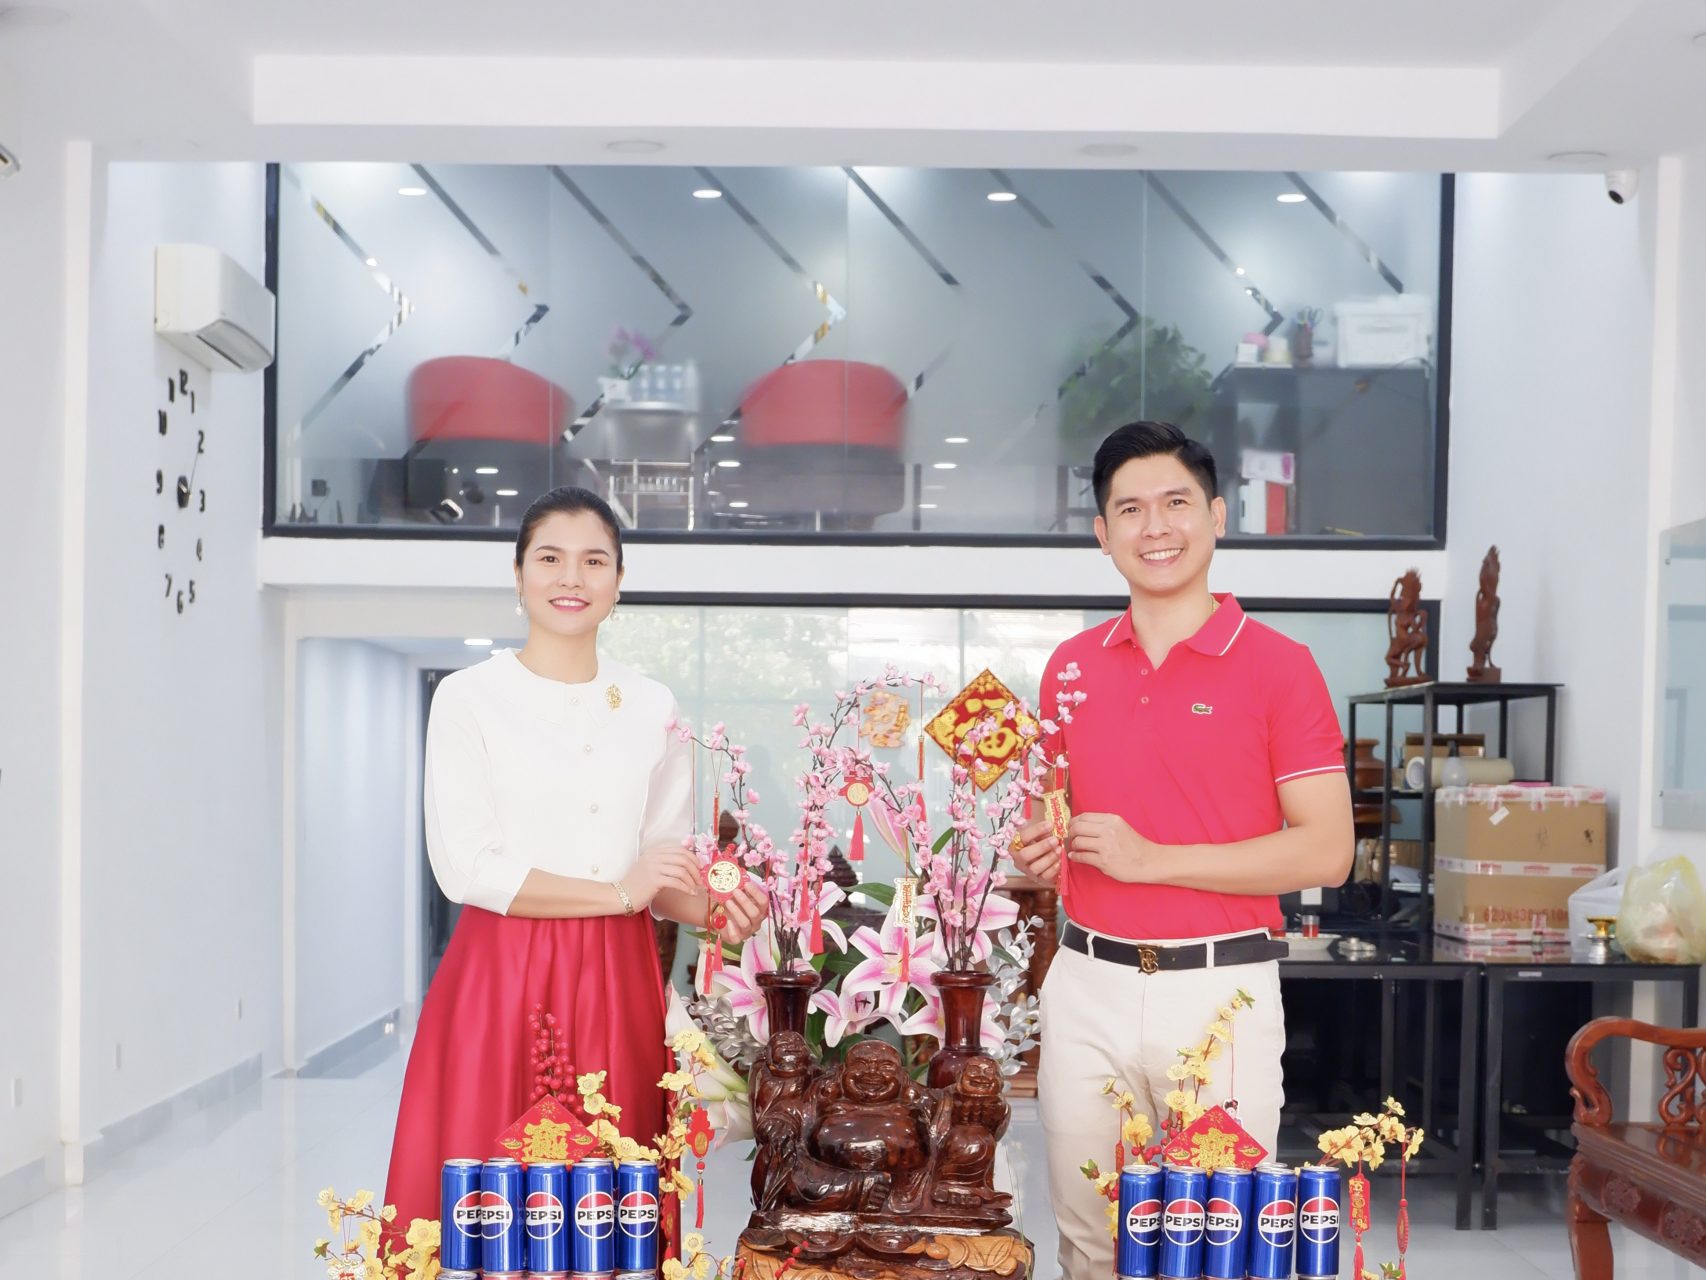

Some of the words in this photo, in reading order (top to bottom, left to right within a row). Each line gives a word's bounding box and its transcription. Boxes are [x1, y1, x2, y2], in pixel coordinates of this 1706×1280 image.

[197, 429, 205, 454] 2
[156, 469, 163, 494] 9
[199, 489, 206, 512] 3
[165, 573, 172, 598] 7
[189, 580, 196, 604] 5
[176, 589, 184, 614] 6
[456, 1209, 481, 1220] PEP
[481, 1210, 510, 1220] EPSI
[620, 1209, 657, 1219] PEPSI
[1302, 1214, 1338, 1225] PEPSI
[1166, 1215, 1203, 1228] PEPSI
[1208, 1215, 1239, 1228] EPSI
[1261, 1217, 1293, 1229] PEPS
